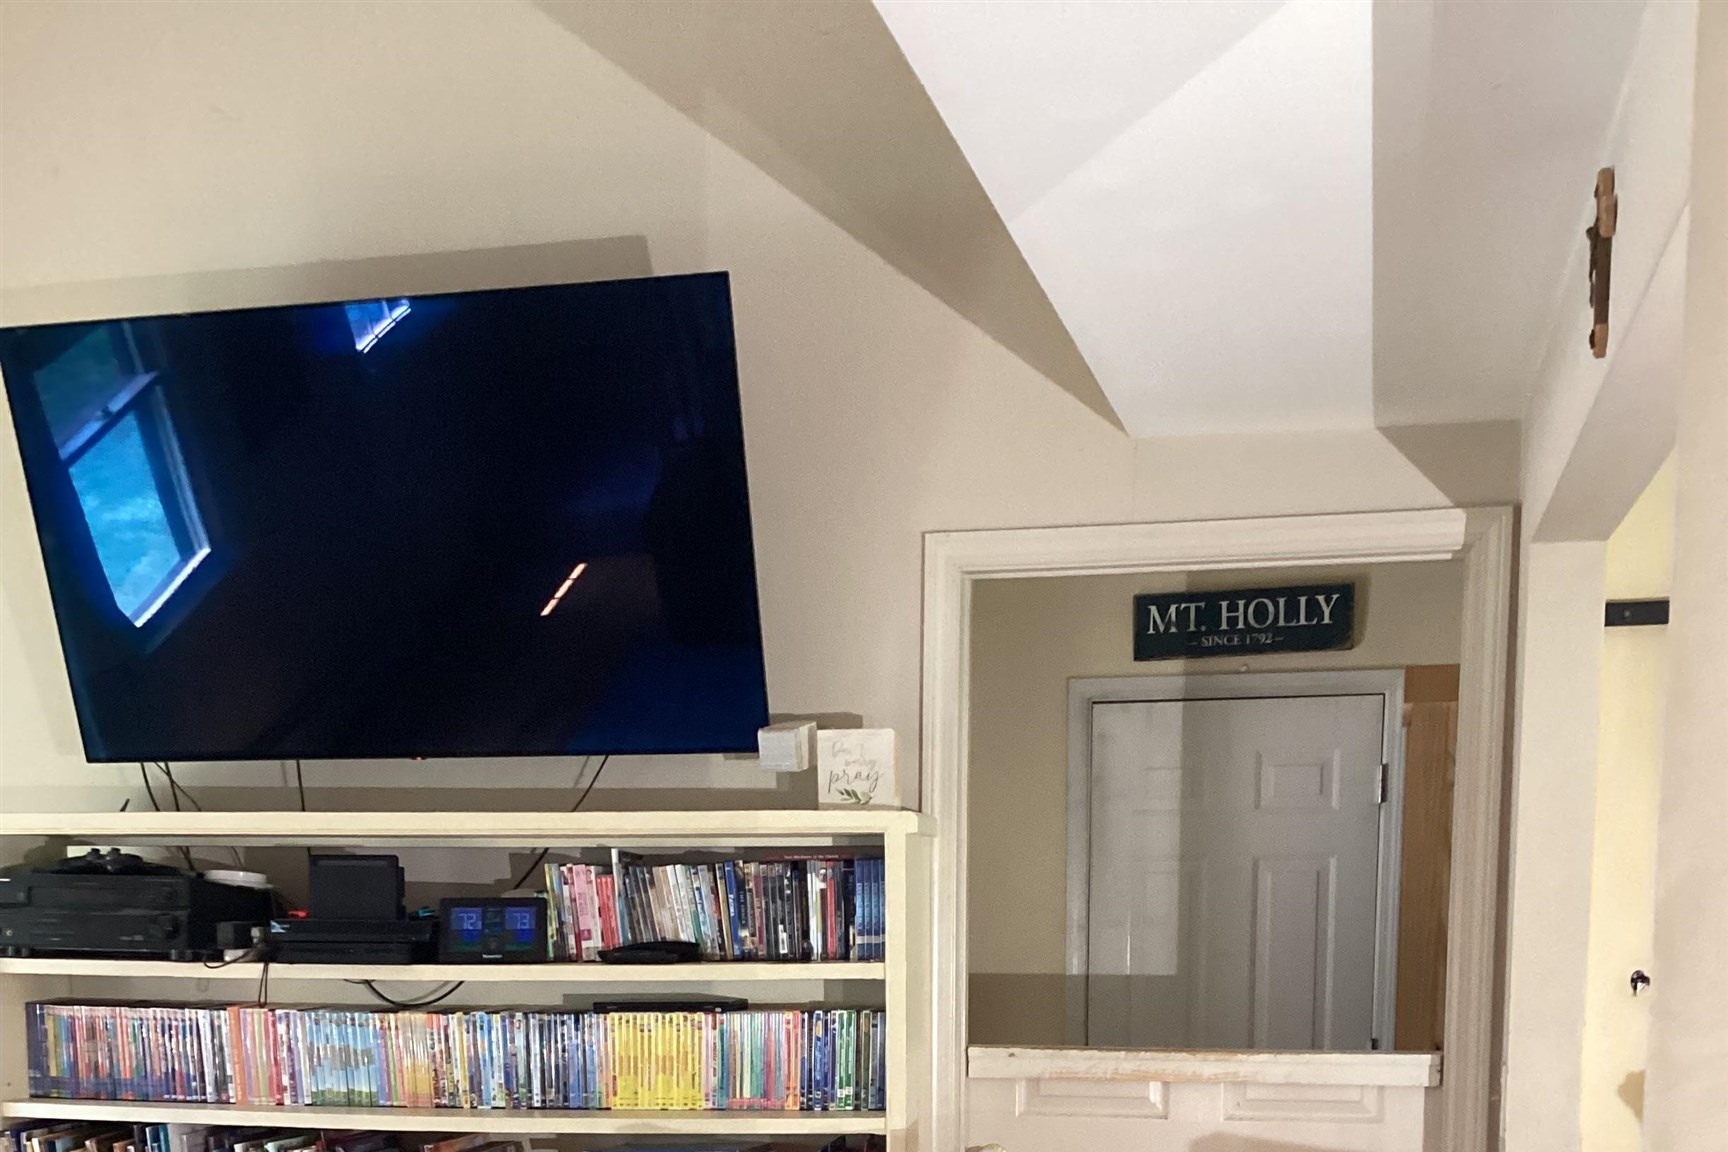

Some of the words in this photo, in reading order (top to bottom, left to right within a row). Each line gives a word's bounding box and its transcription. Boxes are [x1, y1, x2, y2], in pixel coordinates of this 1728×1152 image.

[1147, 602, 1207, 634] MT.
[1218, 594, 1341, 630] HOLLY
[1201, 634, 1241, 647] SINCE
[1245, 632, 1273, 645] 1792
